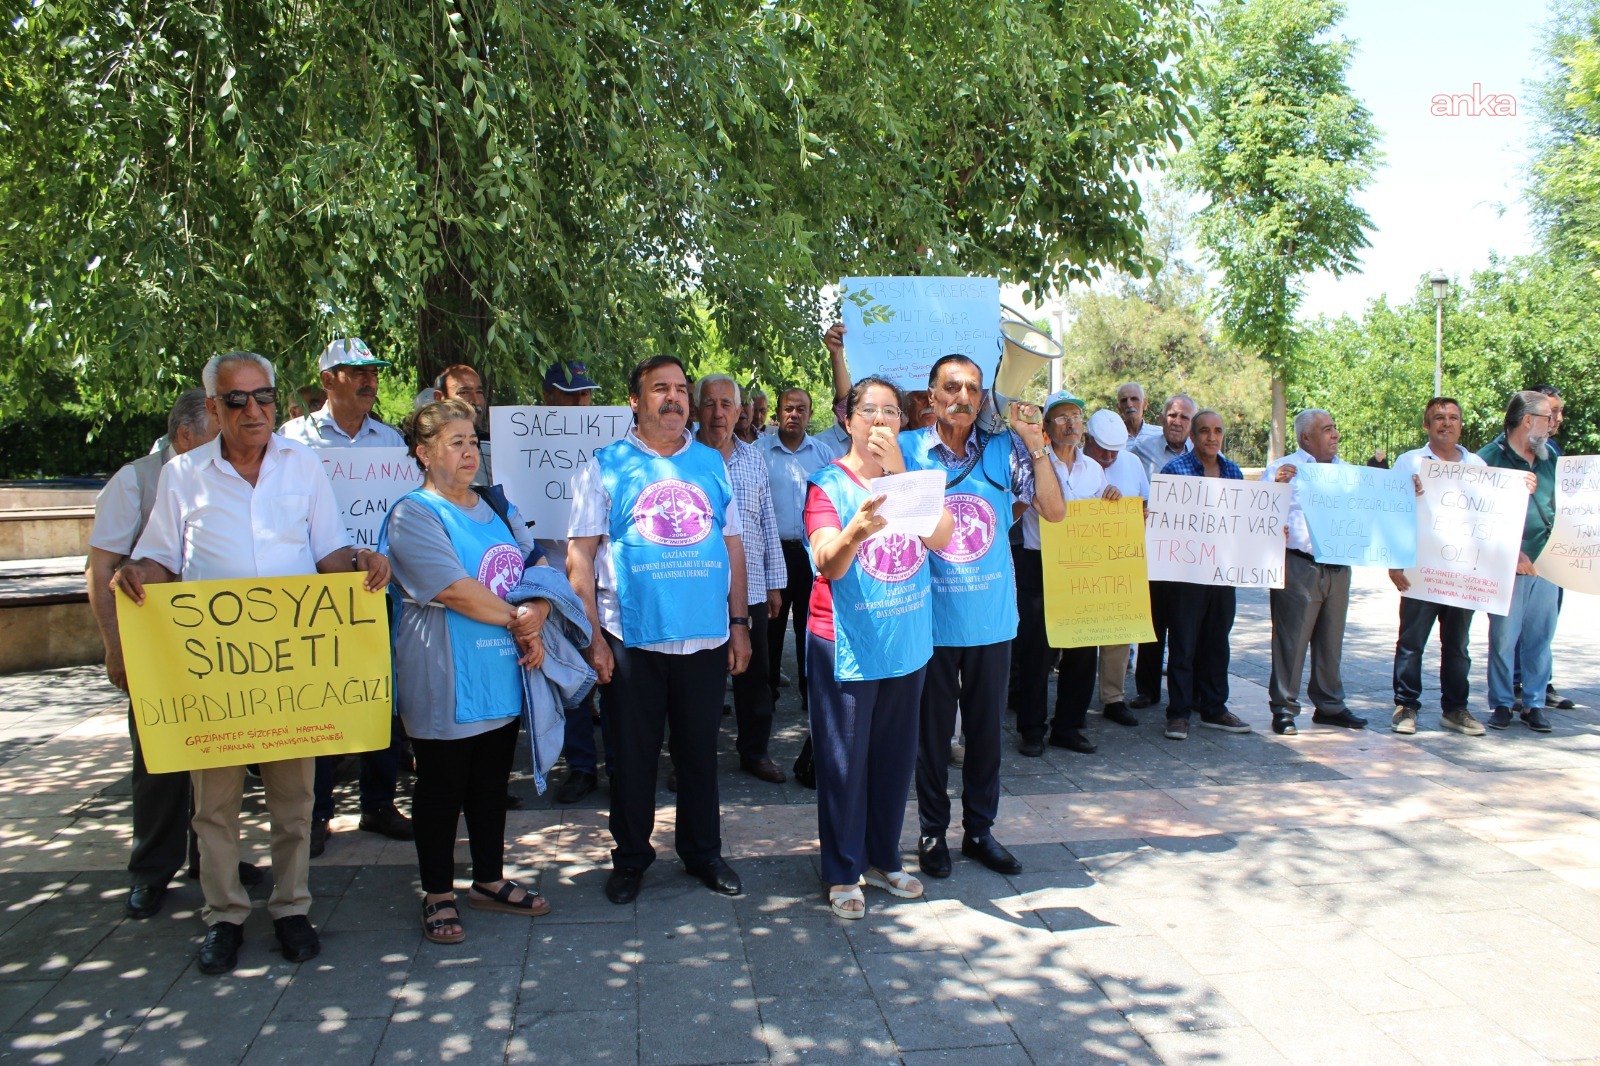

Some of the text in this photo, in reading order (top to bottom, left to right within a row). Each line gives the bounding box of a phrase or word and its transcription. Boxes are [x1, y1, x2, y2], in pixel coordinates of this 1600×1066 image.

[858, 280, 917, 299] TRSM
[520, 447, 602, 469] TASA
[1427, 462, 1512, 489] BARIŞIMIZ
[1151, 480, 1281, 514] TADİLAT YOK
[1383, 479, 1409, 496] HAK
[1149, 511, 1279, 537] TAHRİBAT VAR
[661, 549, 700, 559] GAZİANTEP
[1151, 539, 1217, 566] TRSM
[946, 565, 980, 575] GAZİANTEP
[1212, 565, 1284, 585] AÇILSIN!
[170, 584, 377, 629] SOSYAL
[184, 628, 340, 680] ŞİDDETİ
[184, 730, 245, 747] GAZİANTEP
[200, 746, 211, 754] VE
